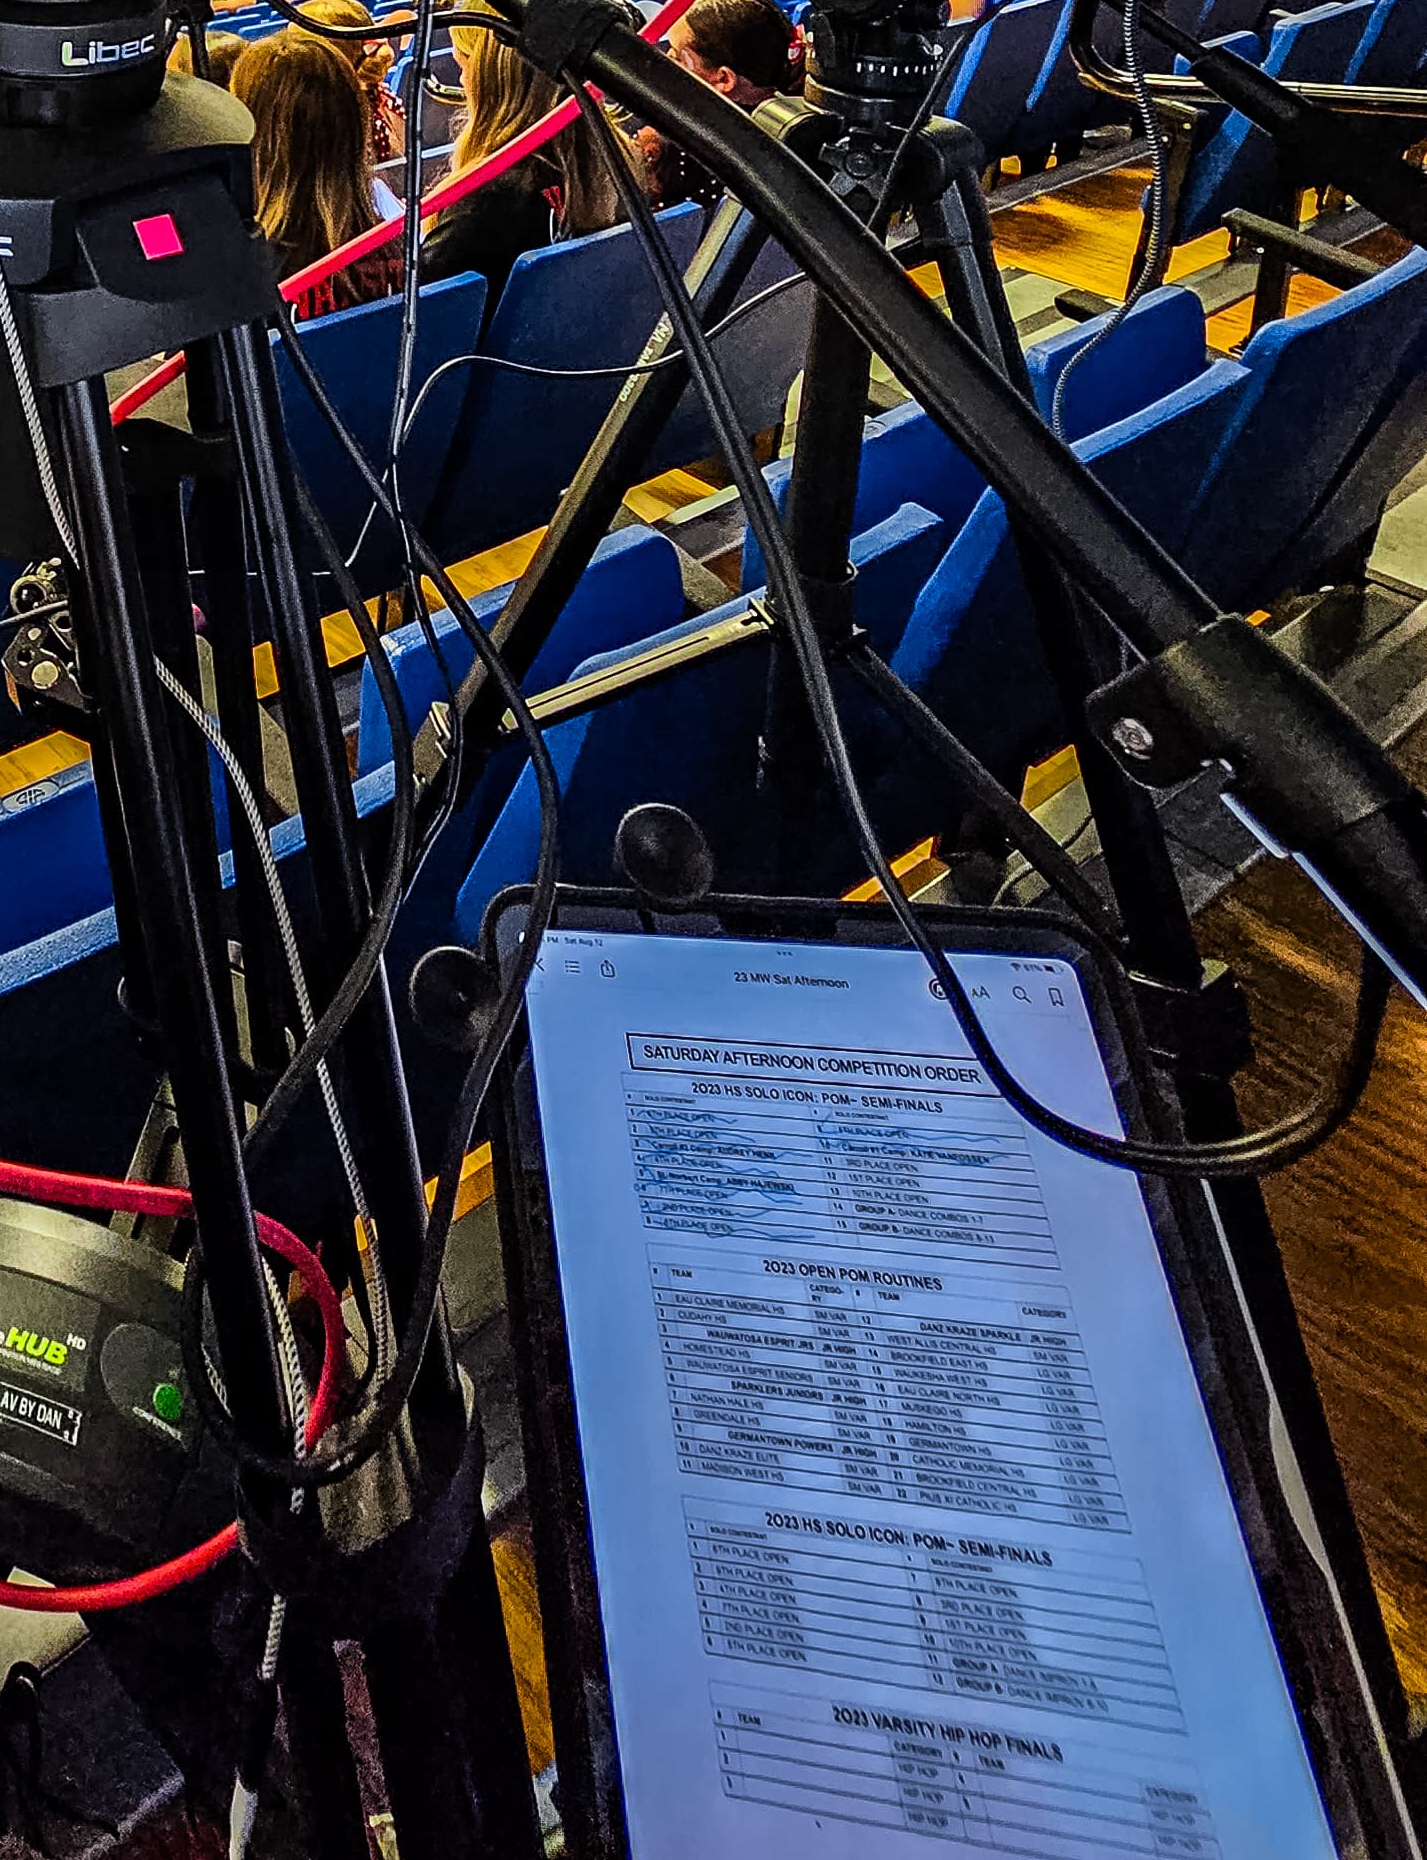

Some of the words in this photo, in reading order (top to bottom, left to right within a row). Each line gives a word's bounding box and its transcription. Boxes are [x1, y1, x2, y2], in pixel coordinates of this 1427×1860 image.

[61, 33, 155, 67] Libec
[733, 971, 748, 984] 23
[750, 972, 771, 985] MW
[773, 974, 793, 986] Sat
[794, 975, 850, 990] Afternoon
[642, 1044, 720, 1064] SATURDAY
[721, 1050, 815, 1071] AFTERNOON
[815, 1057, 922, 1079] COMPETITION
[922, 1065, 982, 1084] ORDER
[691, 1081, 722, 1096] 2023
[724, 1084, 743, 1098] HS
[743, 1085, 781, 1101] SOLO
[781, 1088, 819, 1104] ICON:
[859, 1095, 944, 1114] SEMI-FINALS
[670, 1268, 694, 1279] TEAM
[762, 1259, 797, 1275] 2023
[797, 1263, 837, 1280] OPEN
[837, 1267, 870, 1283] POM
[871, 1270, 944, 1291] ROUTINES
[877, 1290, 901, 1301] TEAM
[5, 1326, 68, 1366] HUB
[67, 1332, 87, 1351] HD
[0, 1388, 18, 1411] AV
[18, 1394, 35, 1418] BY
[36, 1403, 63, 1430] DAN
[764, 1511, 800, 1530] 2023
[801, 1516, 823, 1533] HS
[824, 1520, 867, 1540] SOLO
[956, 1537, 1054, 1567] SEMI-FINALS
[831, 1705, 870, 1729] 2023
[869, 1711, 938, 1741] VARSITY
[937, 1723, 968, 1746] HIP
[966, 1727, 1005, 1752] HOP
[1003, 1734, 1065, 1764] FINALS
